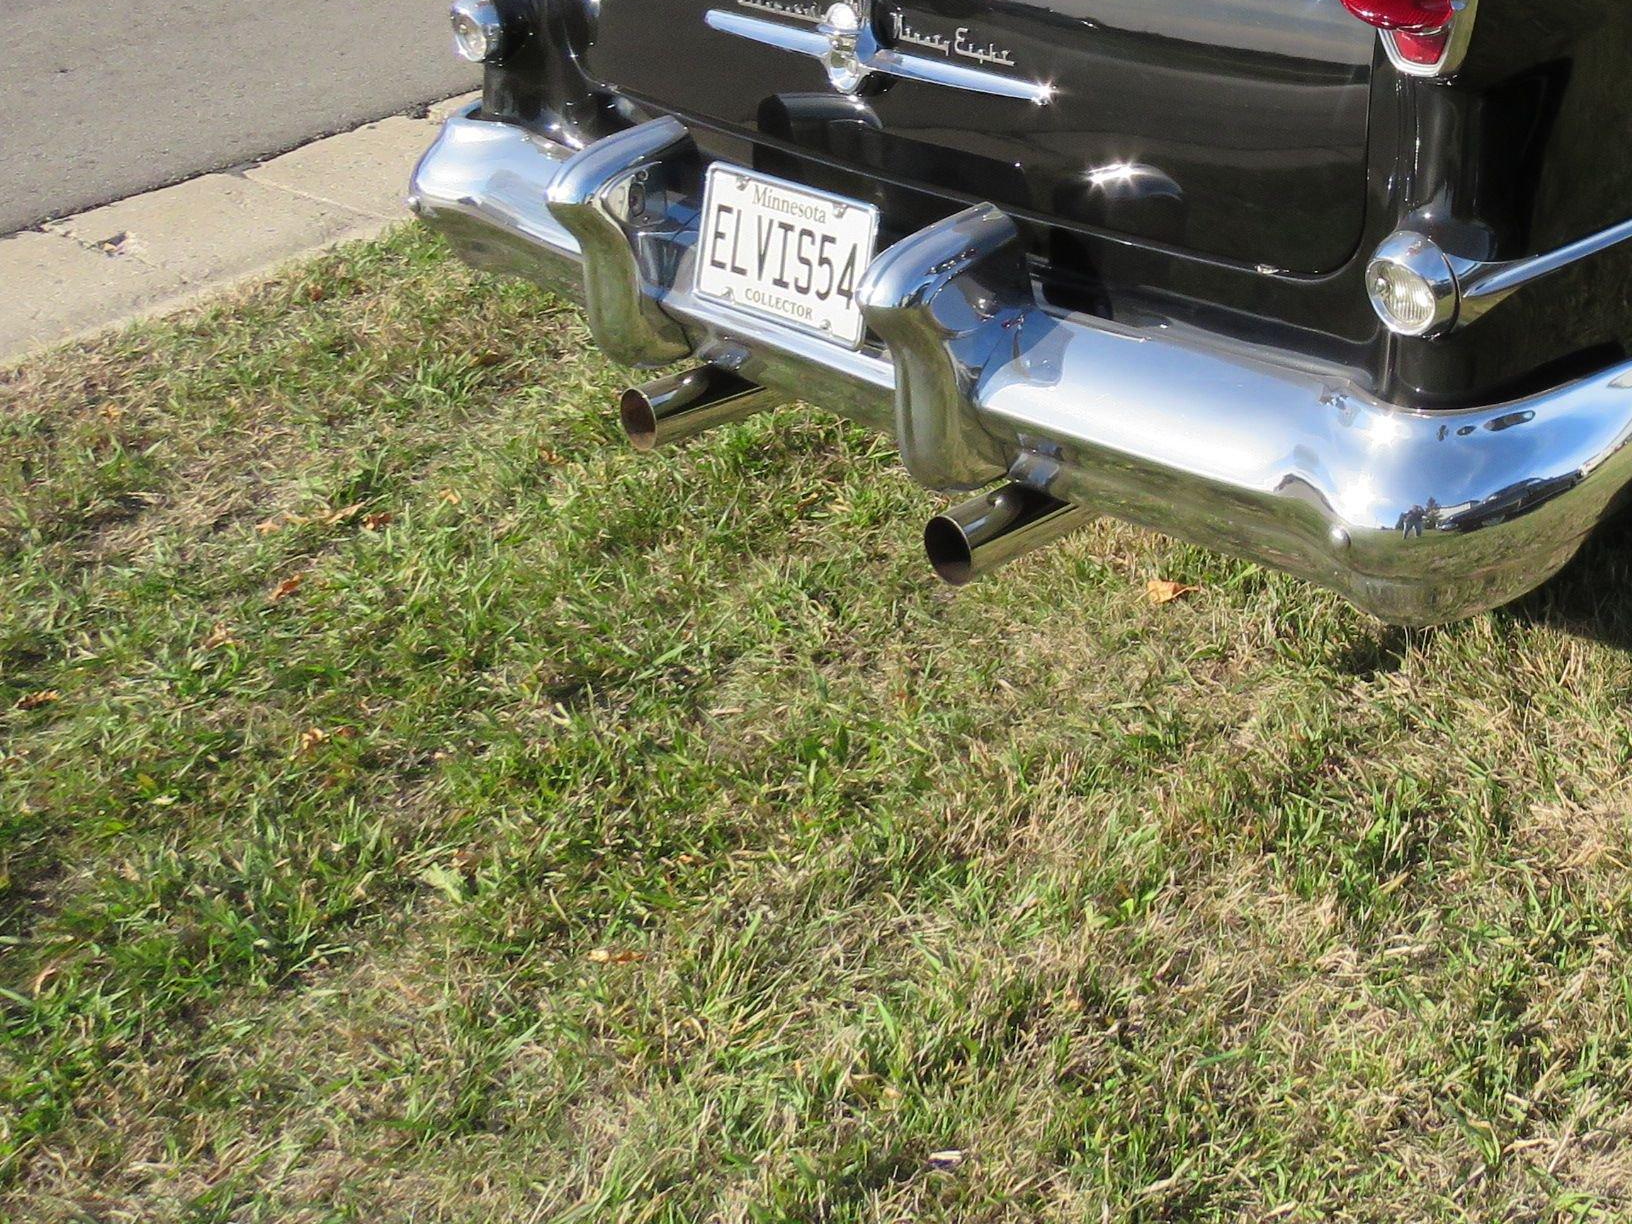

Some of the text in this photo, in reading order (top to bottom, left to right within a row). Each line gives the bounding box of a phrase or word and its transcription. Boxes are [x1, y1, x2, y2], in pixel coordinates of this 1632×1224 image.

[752, 184, 827, 224] Minnesota
[709, 204, 859, 310] ELVIS54
[744, 287, 814, 320] COLLECTOR
